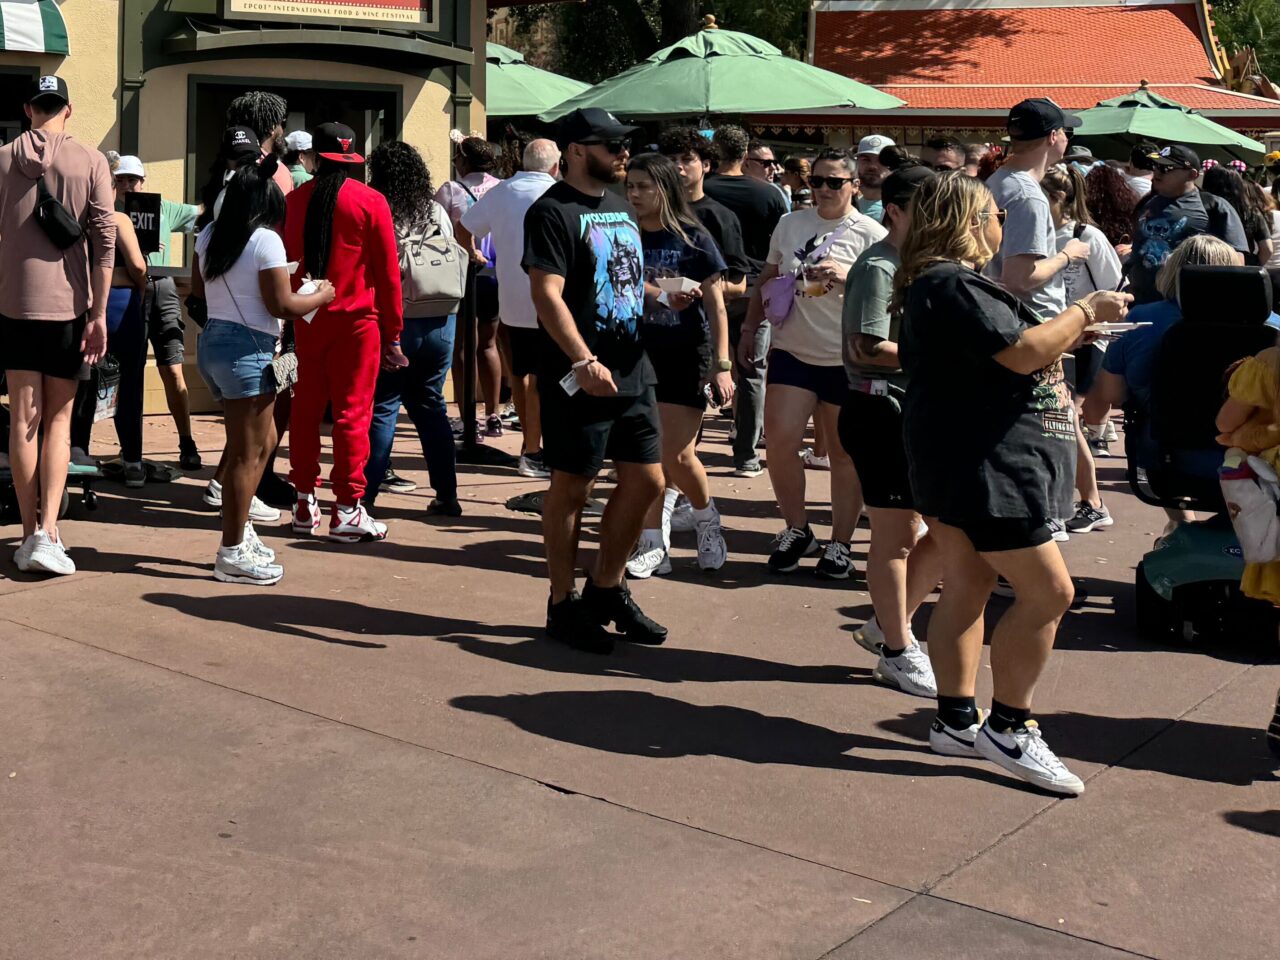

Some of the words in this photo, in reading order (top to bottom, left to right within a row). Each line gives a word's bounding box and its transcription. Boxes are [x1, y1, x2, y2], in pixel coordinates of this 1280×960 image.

[273, 5, 331, 15] INTERNATIONAL
[381, 12, 414, 20] FESTIVAL
[232, 138, 252, 146] CHANEL
[129, 211, 155, 230] EXIT
